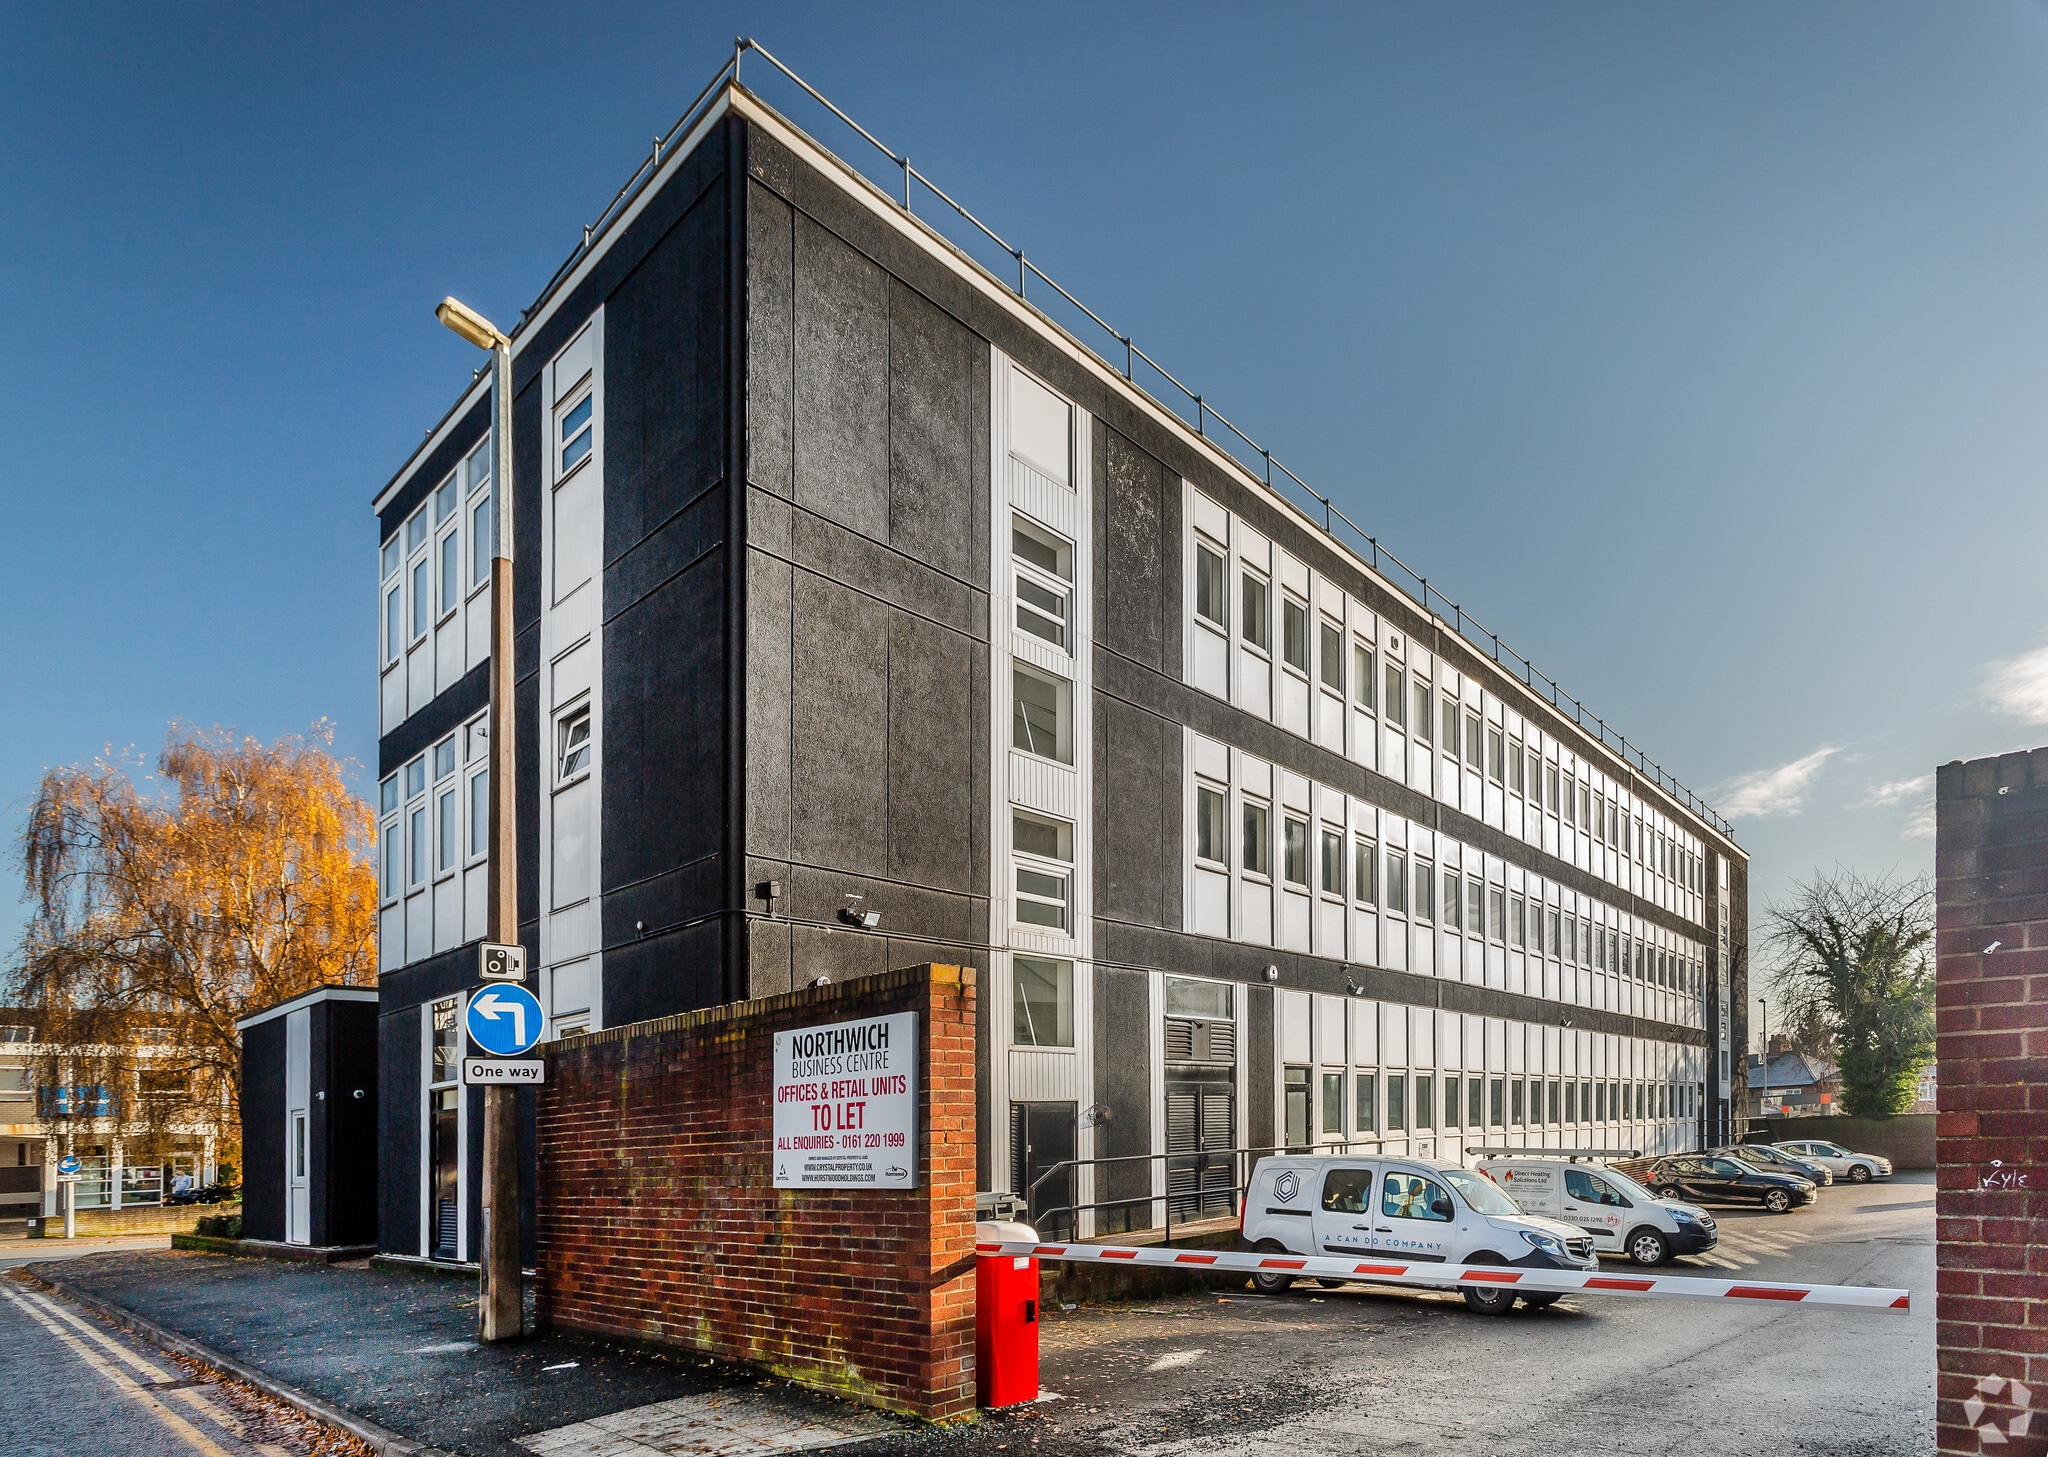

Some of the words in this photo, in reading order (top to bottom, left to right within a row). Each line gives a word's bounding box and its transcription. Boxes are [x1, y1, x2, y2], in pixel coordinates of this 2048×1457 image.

[792, 1023, 889, 1060] NORTHWICH
[472, 1065, 504, 1077] One
[509, 1068, 539, 1079] way
[792, 1055, 842, 1078] BUSINESS
[846, 1050, 889, 1072] CENTRE
[777, 1082, 818, 1103] OFFICES
[820, 1083, 829, 1100] &
[831, 1078, 869, 1099] RETAIL
[871, 1074, 907, 1096] UNITS
[811, 1104, 832, 1131] TO
[837, 1101, 866, 1130] LET
[777, 1136, 792, 1150] ALL
[793, 1135, 834, 1150] ENQUIRIES
[842, 1134, 862, 1149] 0161
[864, 1133, 881, 1148] 220
[883, 1132, 905, 1148] 1999
[804, 1162, 873, 1171] WWW.CRYSTALPROPERTY.CO.UK
[801, 1173, 876, 1182] WWW.HURSTWOODHOLDINGS.COM
[1337, 1235, 1358, 1243] CAN
[1365, 1237, 1379, 1245] DO
[1386, 1239, 1442, 1250] COMPANY
